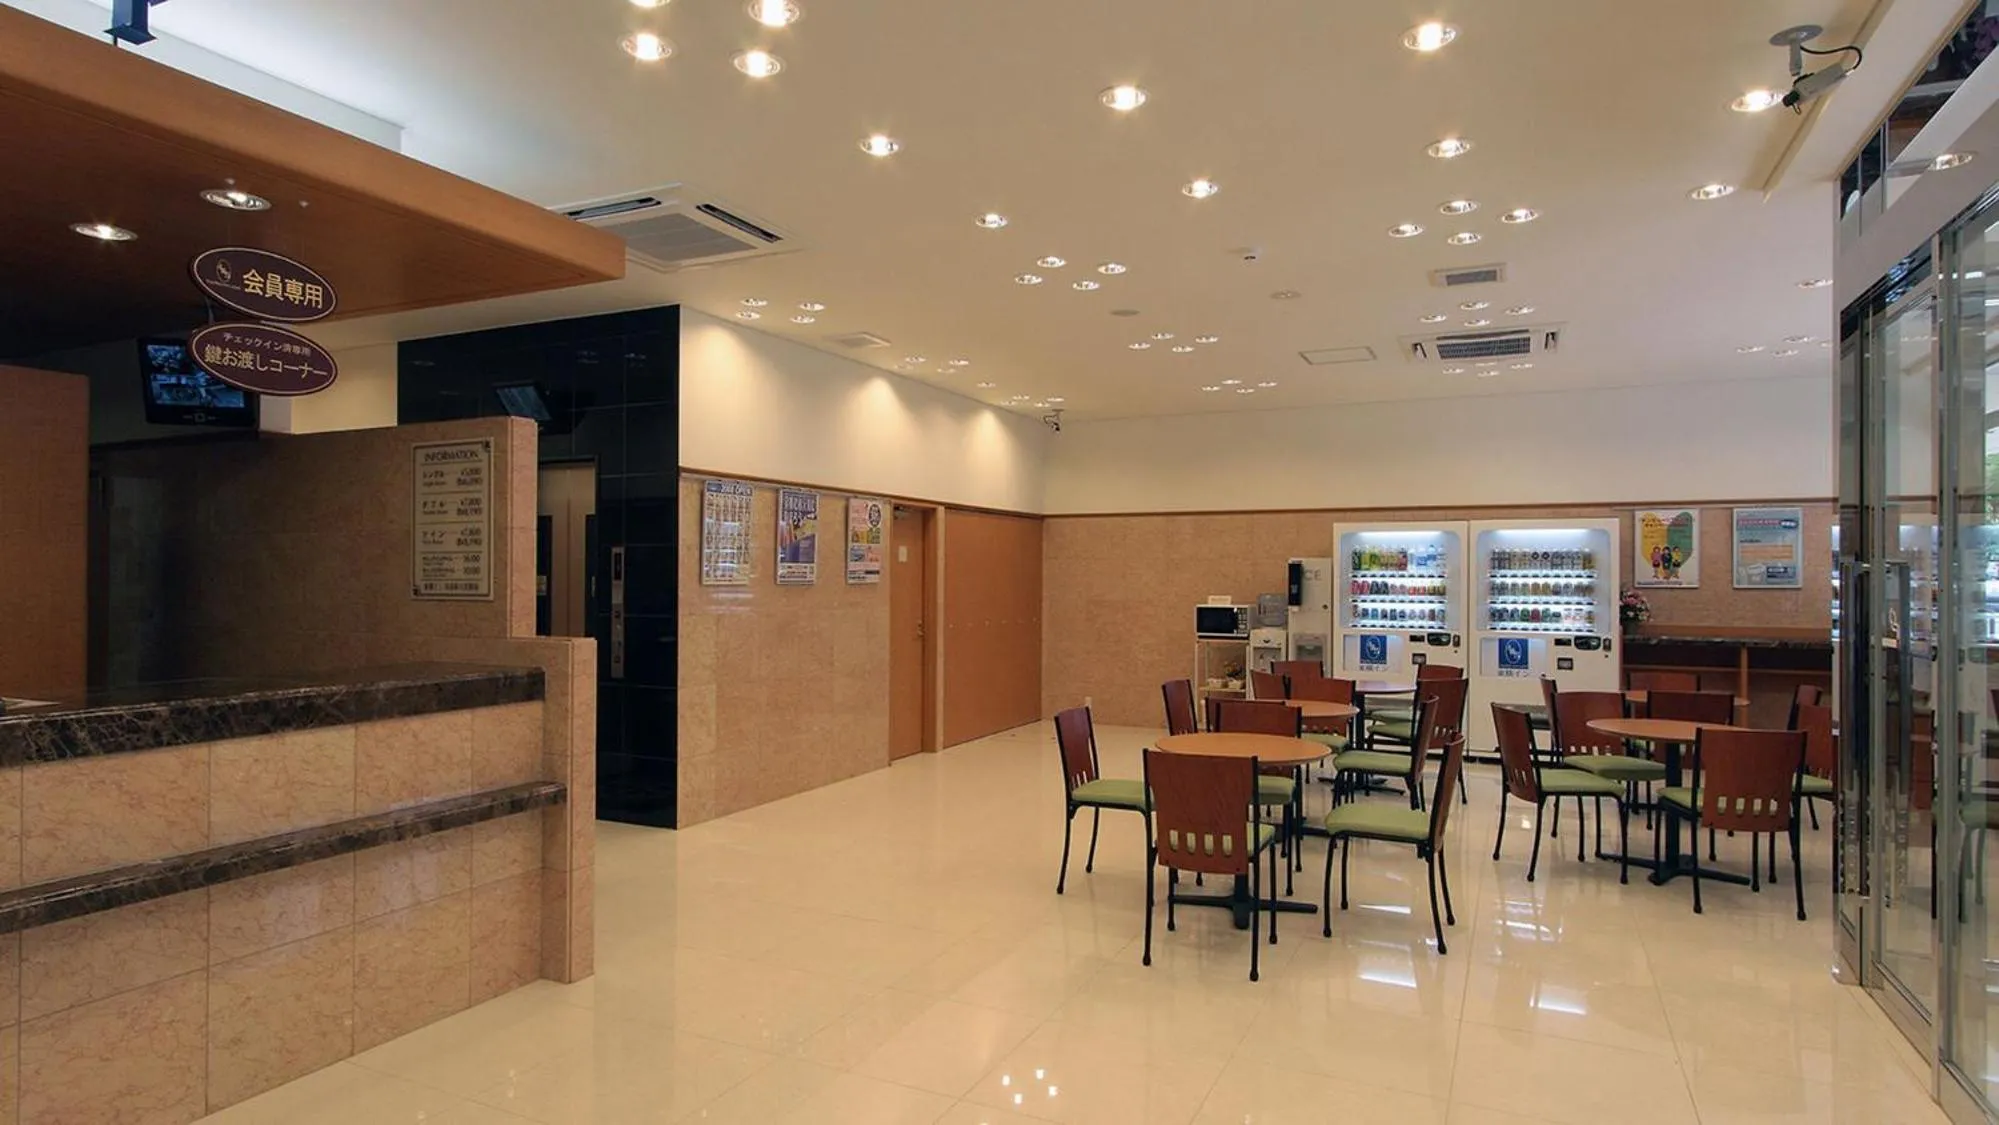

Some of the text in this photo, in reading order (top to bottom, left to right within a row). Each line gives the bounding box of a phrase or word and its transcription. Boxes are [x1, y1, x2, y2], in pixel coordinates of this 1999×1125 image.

[243, 268, 324, 309] 会員専用
[204, 343, 328, 378] 鍵お渡しコーナー
[424, 450, 479, 462] INFORMATION
